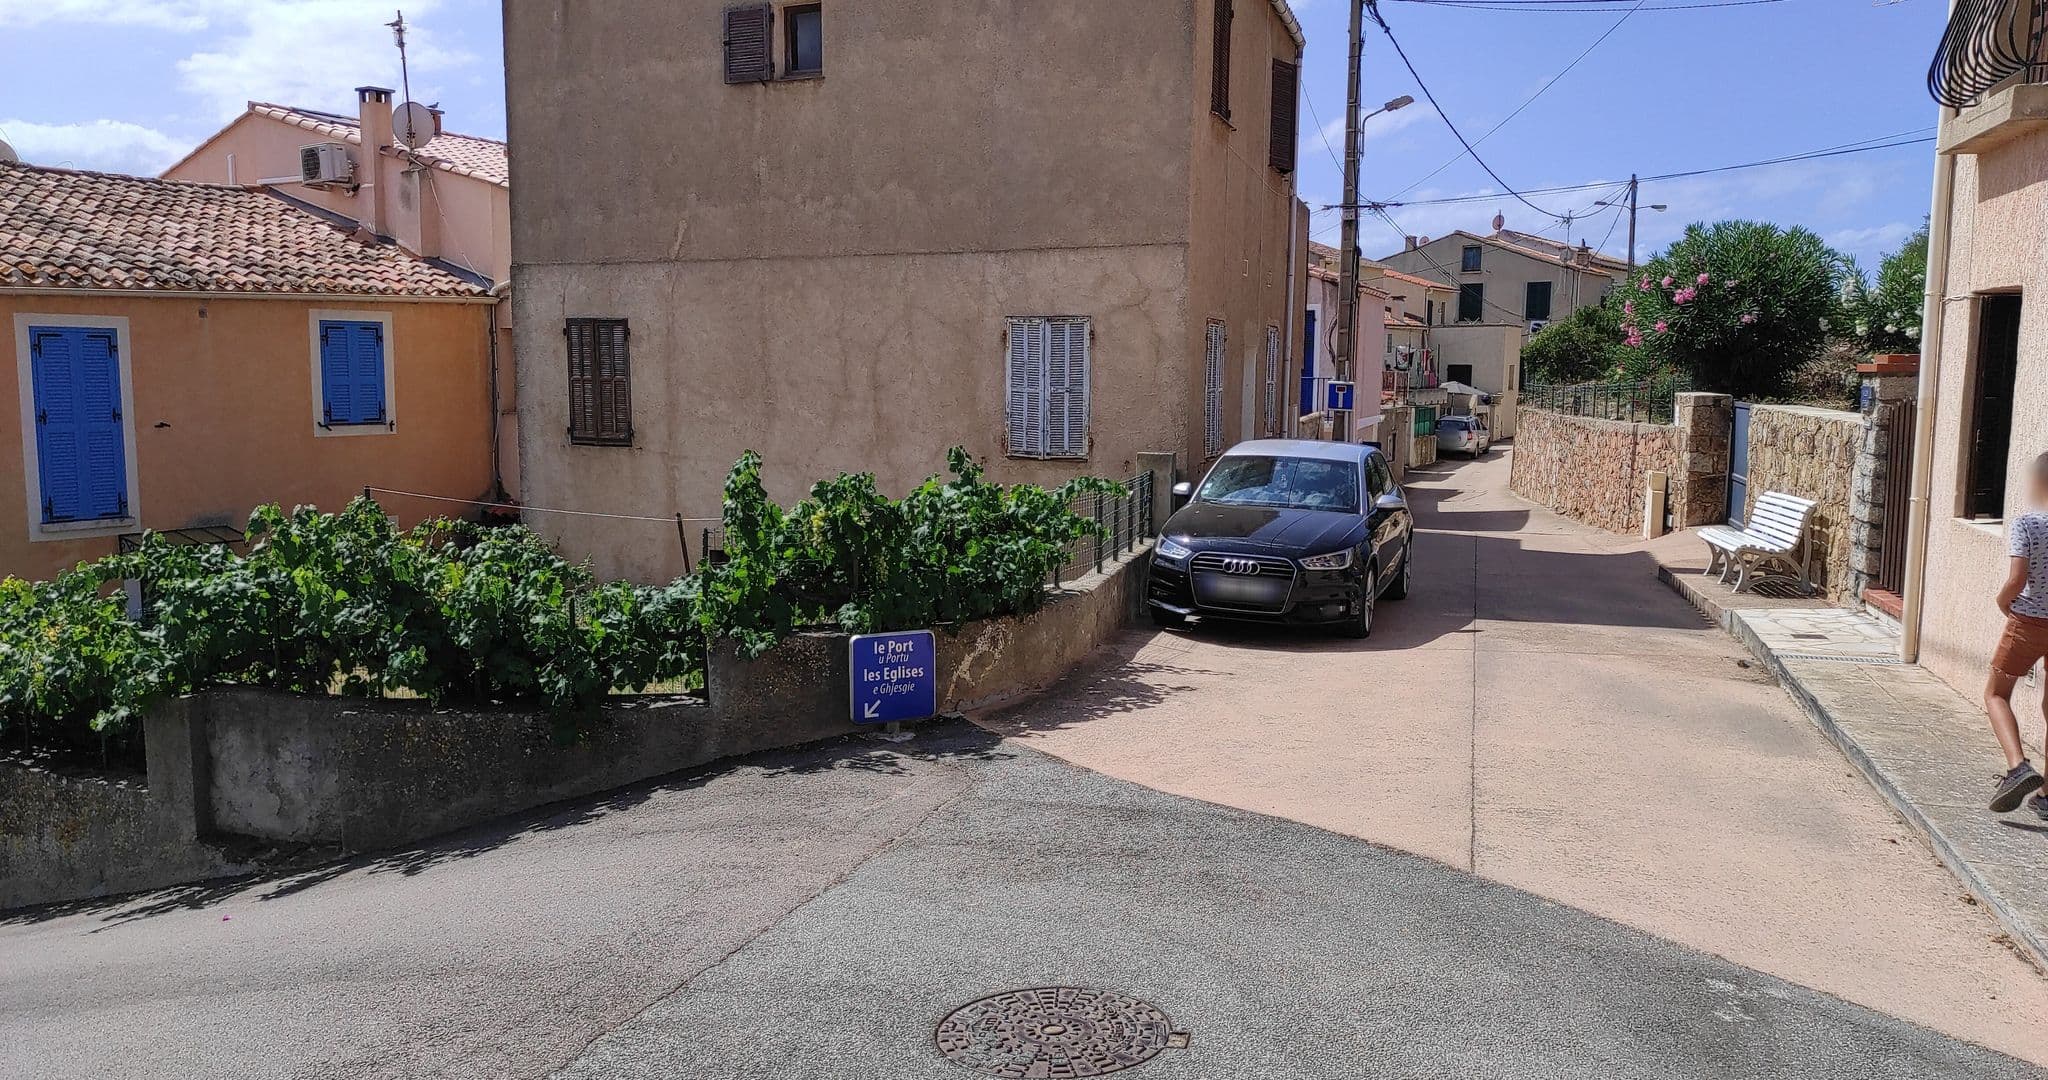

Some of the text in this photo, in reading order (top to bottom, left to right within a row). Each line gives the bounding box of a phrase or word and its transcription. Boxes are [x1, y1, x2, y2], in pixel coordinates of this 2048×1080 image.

[874, 640, 914, 655] le Port
[879, 653, 909, 664] u Portu
[864, 666, 924, 682] les Eglises
[873, 681, 915, 696] e Ghjesgie
